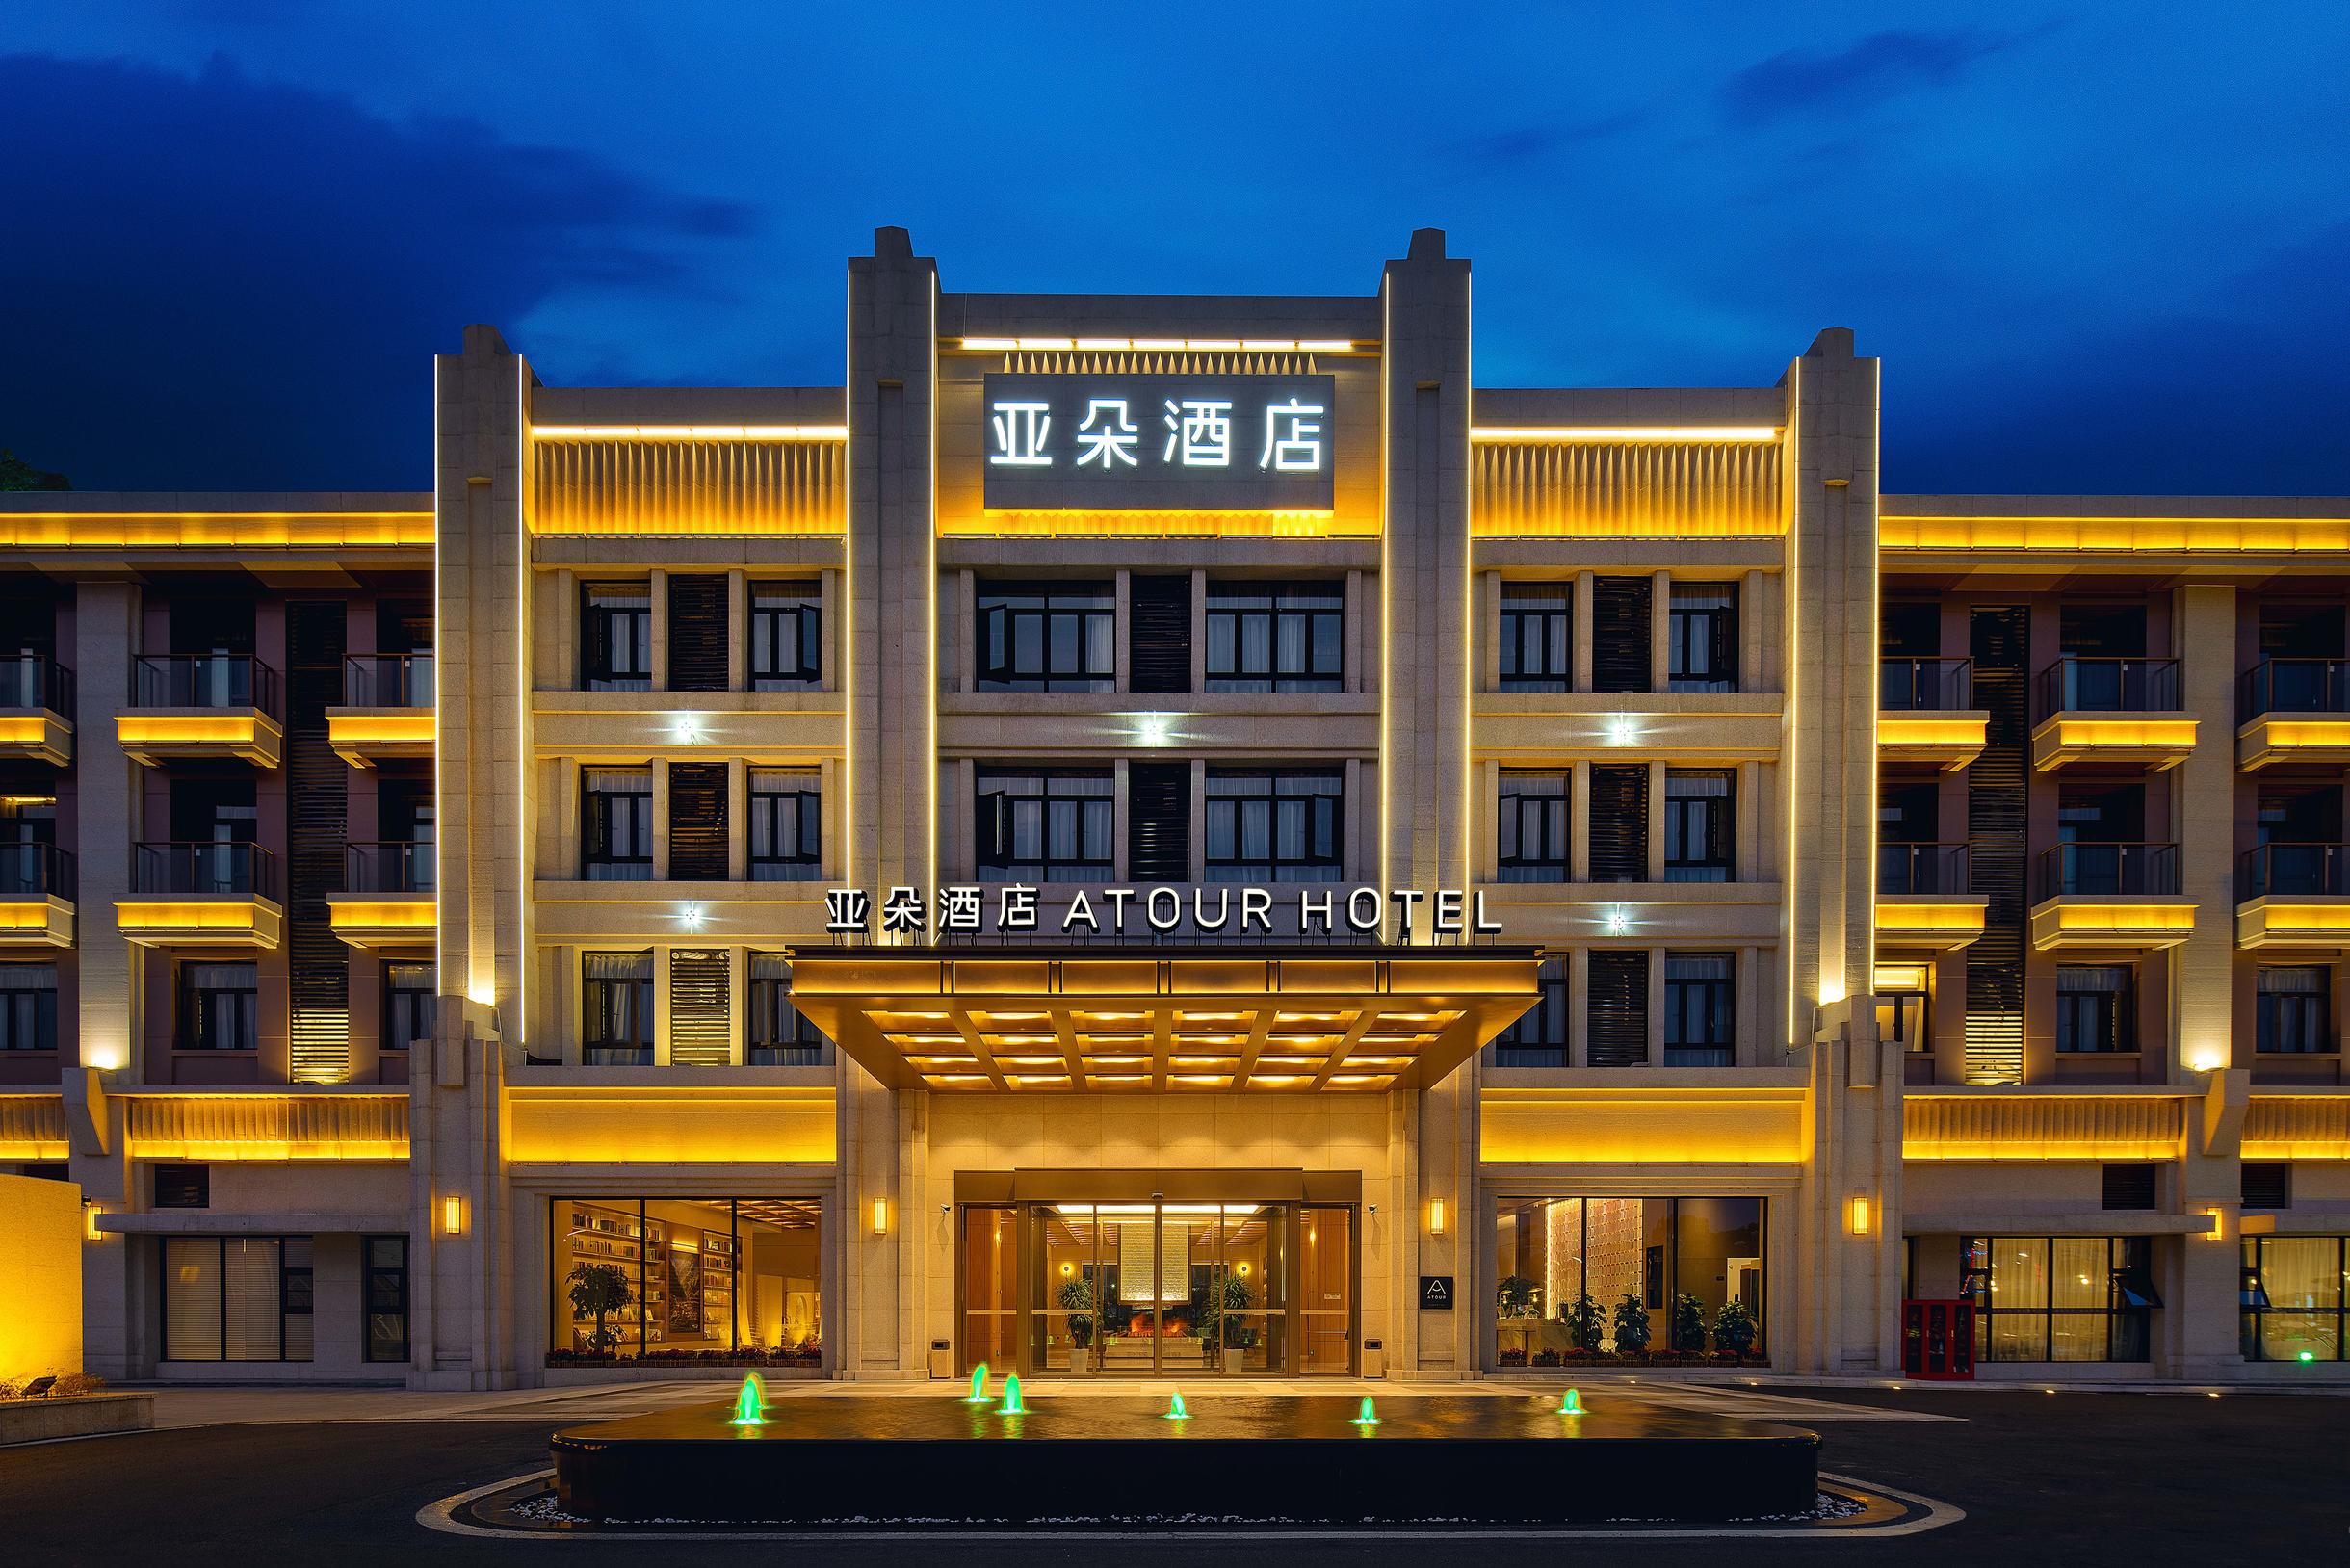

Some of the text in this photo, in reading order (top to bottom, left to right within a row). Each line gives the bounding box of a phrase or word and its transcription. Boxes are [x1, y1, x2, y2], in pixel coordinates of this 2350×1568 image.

[990, 398, 1324, 471] 亚朵酒店
[824, 883, 1502, 928] 亚朵酒店 ATOUR HOTEL
